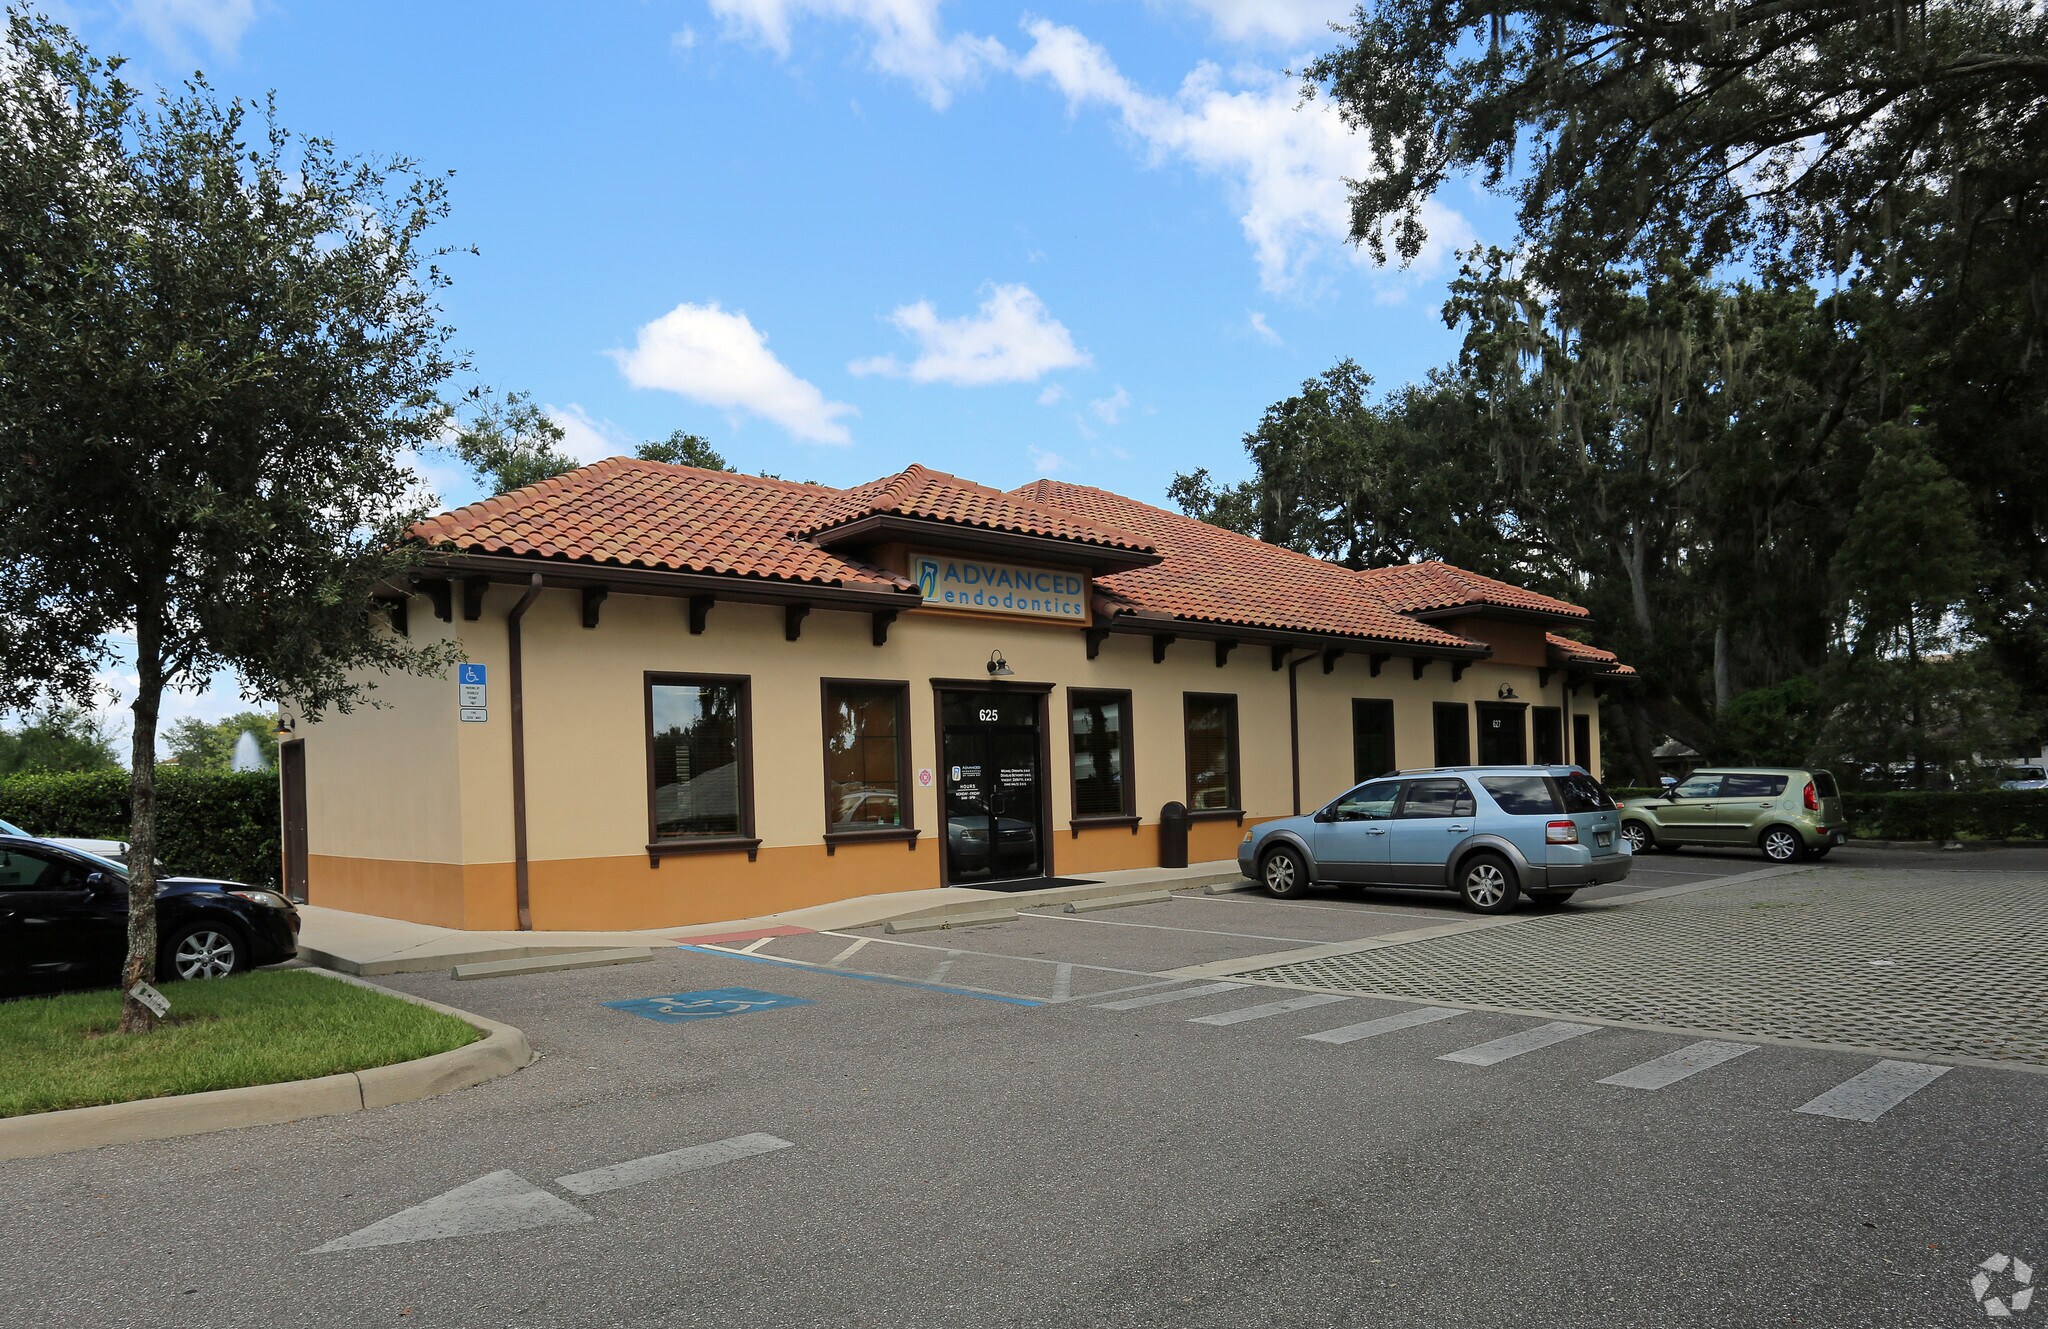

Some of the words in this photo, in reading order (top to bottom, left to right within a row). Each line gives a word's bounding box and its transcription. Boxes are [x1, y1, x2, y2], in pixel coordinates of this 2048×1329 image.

[944, 563, 1081, 595] ADVANCED
[945, 589, 1081, 614] endodontics
[979, 709, 998, 721] 625
[1493, 719, 1501, 728] 627
